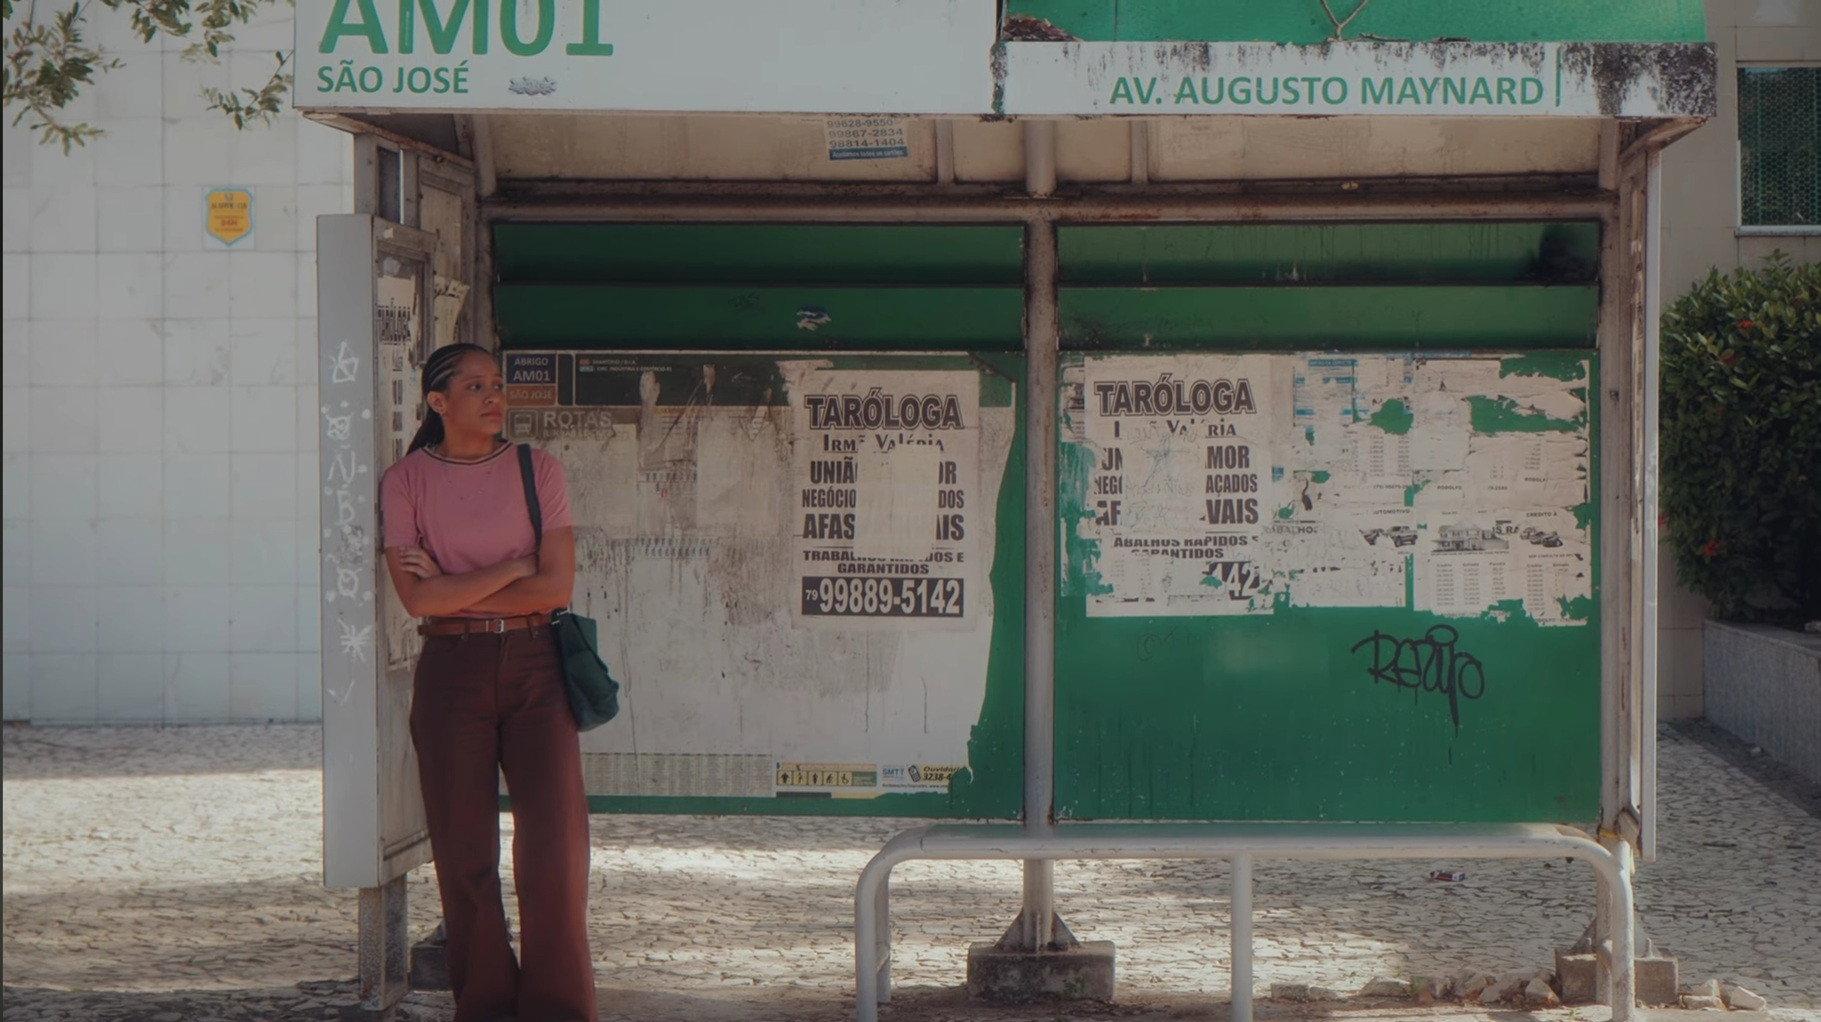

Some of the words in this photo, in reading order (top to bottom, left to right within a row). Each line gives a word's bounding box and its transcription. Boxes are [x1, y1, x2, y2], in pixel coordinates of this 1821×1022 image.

[318, 0, 613, 56] AM01
[317, 60, 384, 93] SÃO
[393, 60, 470, 93] JOSÉ
[1109, 76, 1162, 105] AV.
[1174, 75, 1350, 106] AUGUSTO
[1362, 75, 1544, 105] MAYNARD
[513, 370, 551, 382] AM01
[804, 387, 965, 430] TARÓLOGA
[1093, 373, 1258, 417] TARÓLOGA
[543, 410, 613, 430] ROTAS
[810, 456, 858, 484] UNIÃ
[1205, 445, 1250, 470] MOR
[802, 487, 857, 508] NEGÓCIO
[838, 563, 930, 575] GARANTIDOS
[957, 552, 967, 563] E
[805, 589, 819, 601] 79
[819, 577, 962, 614] 99889-5142
